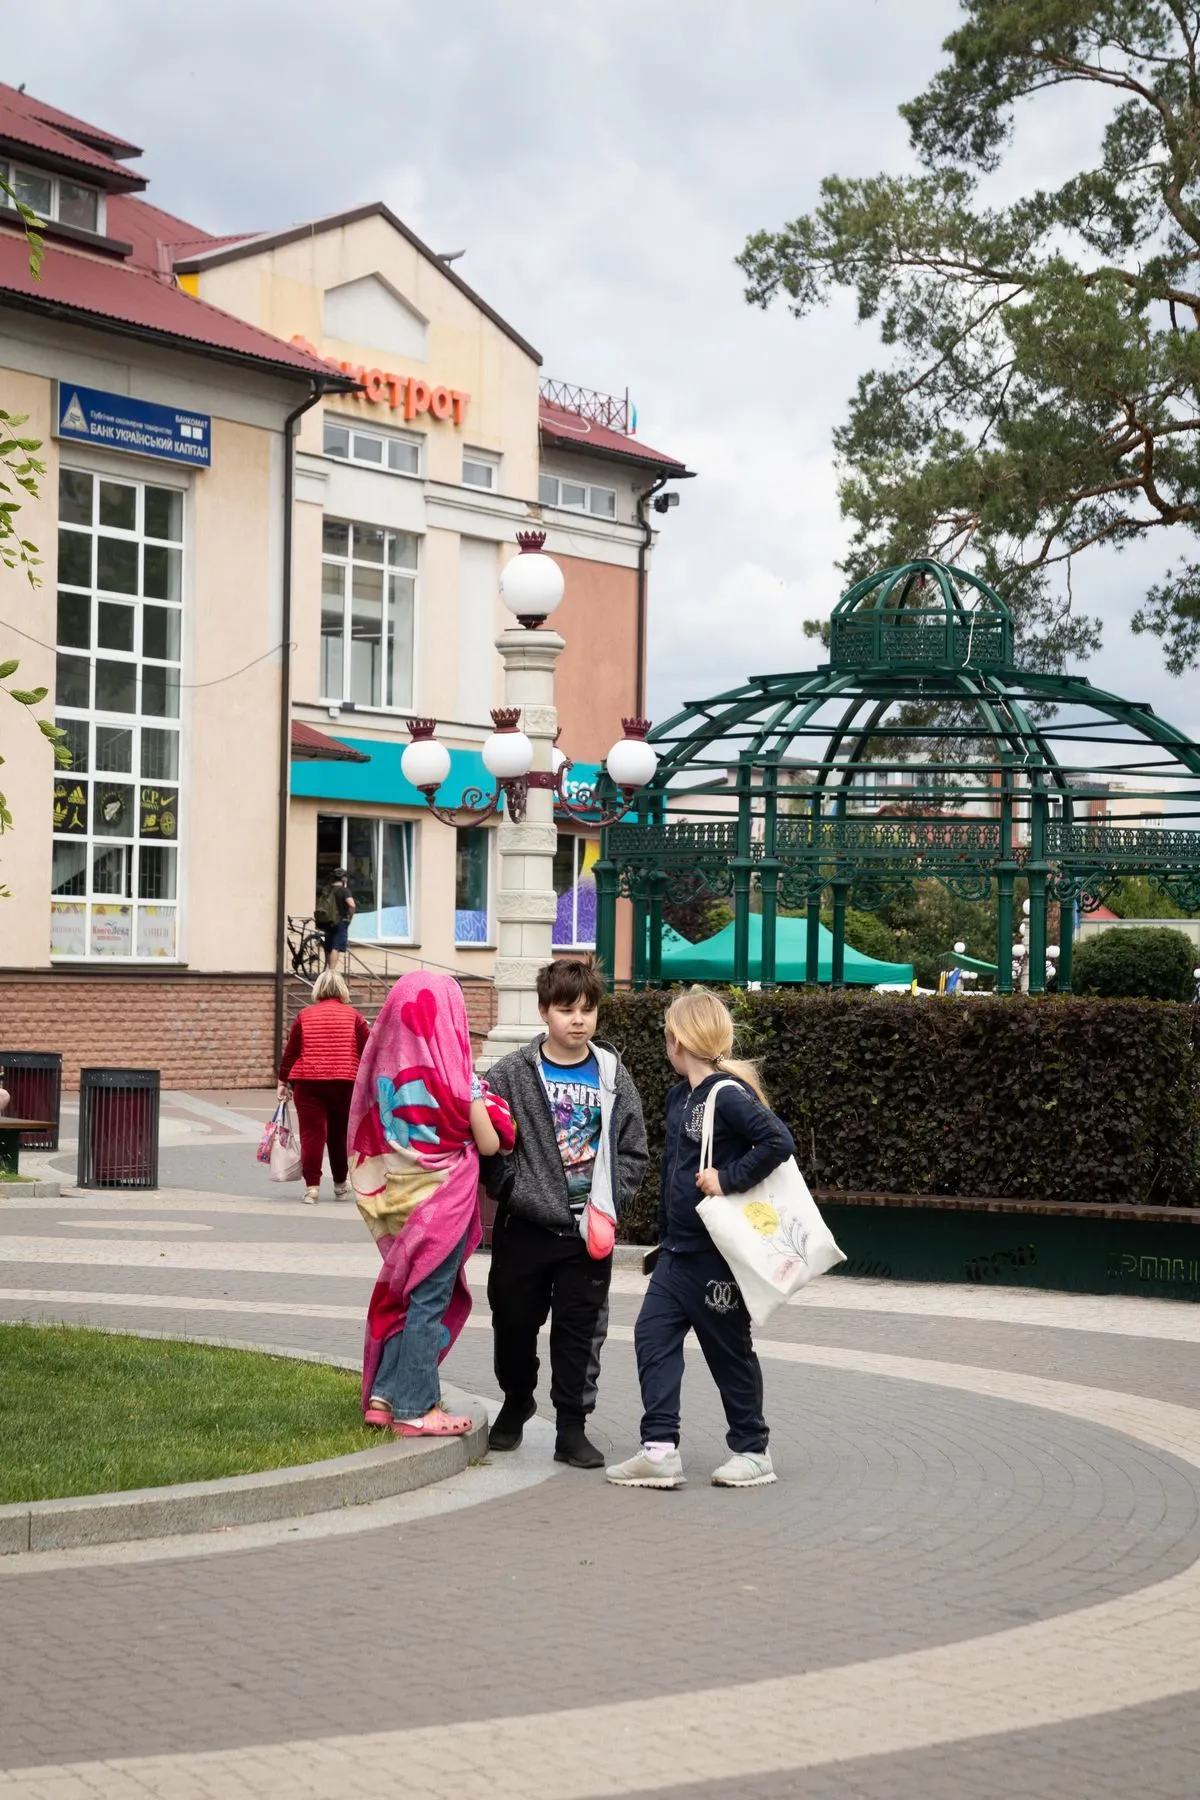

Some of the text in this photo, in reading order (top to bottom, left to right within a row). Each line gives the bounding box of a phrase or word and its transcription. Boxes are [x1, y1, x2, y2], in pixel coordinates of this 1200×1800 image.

[175, 414, 209, 429] БАНКОМАТ
[90, 423, 209, 459] БАНК УКРАЇНСЬКИЙ КАПІТАЛ
